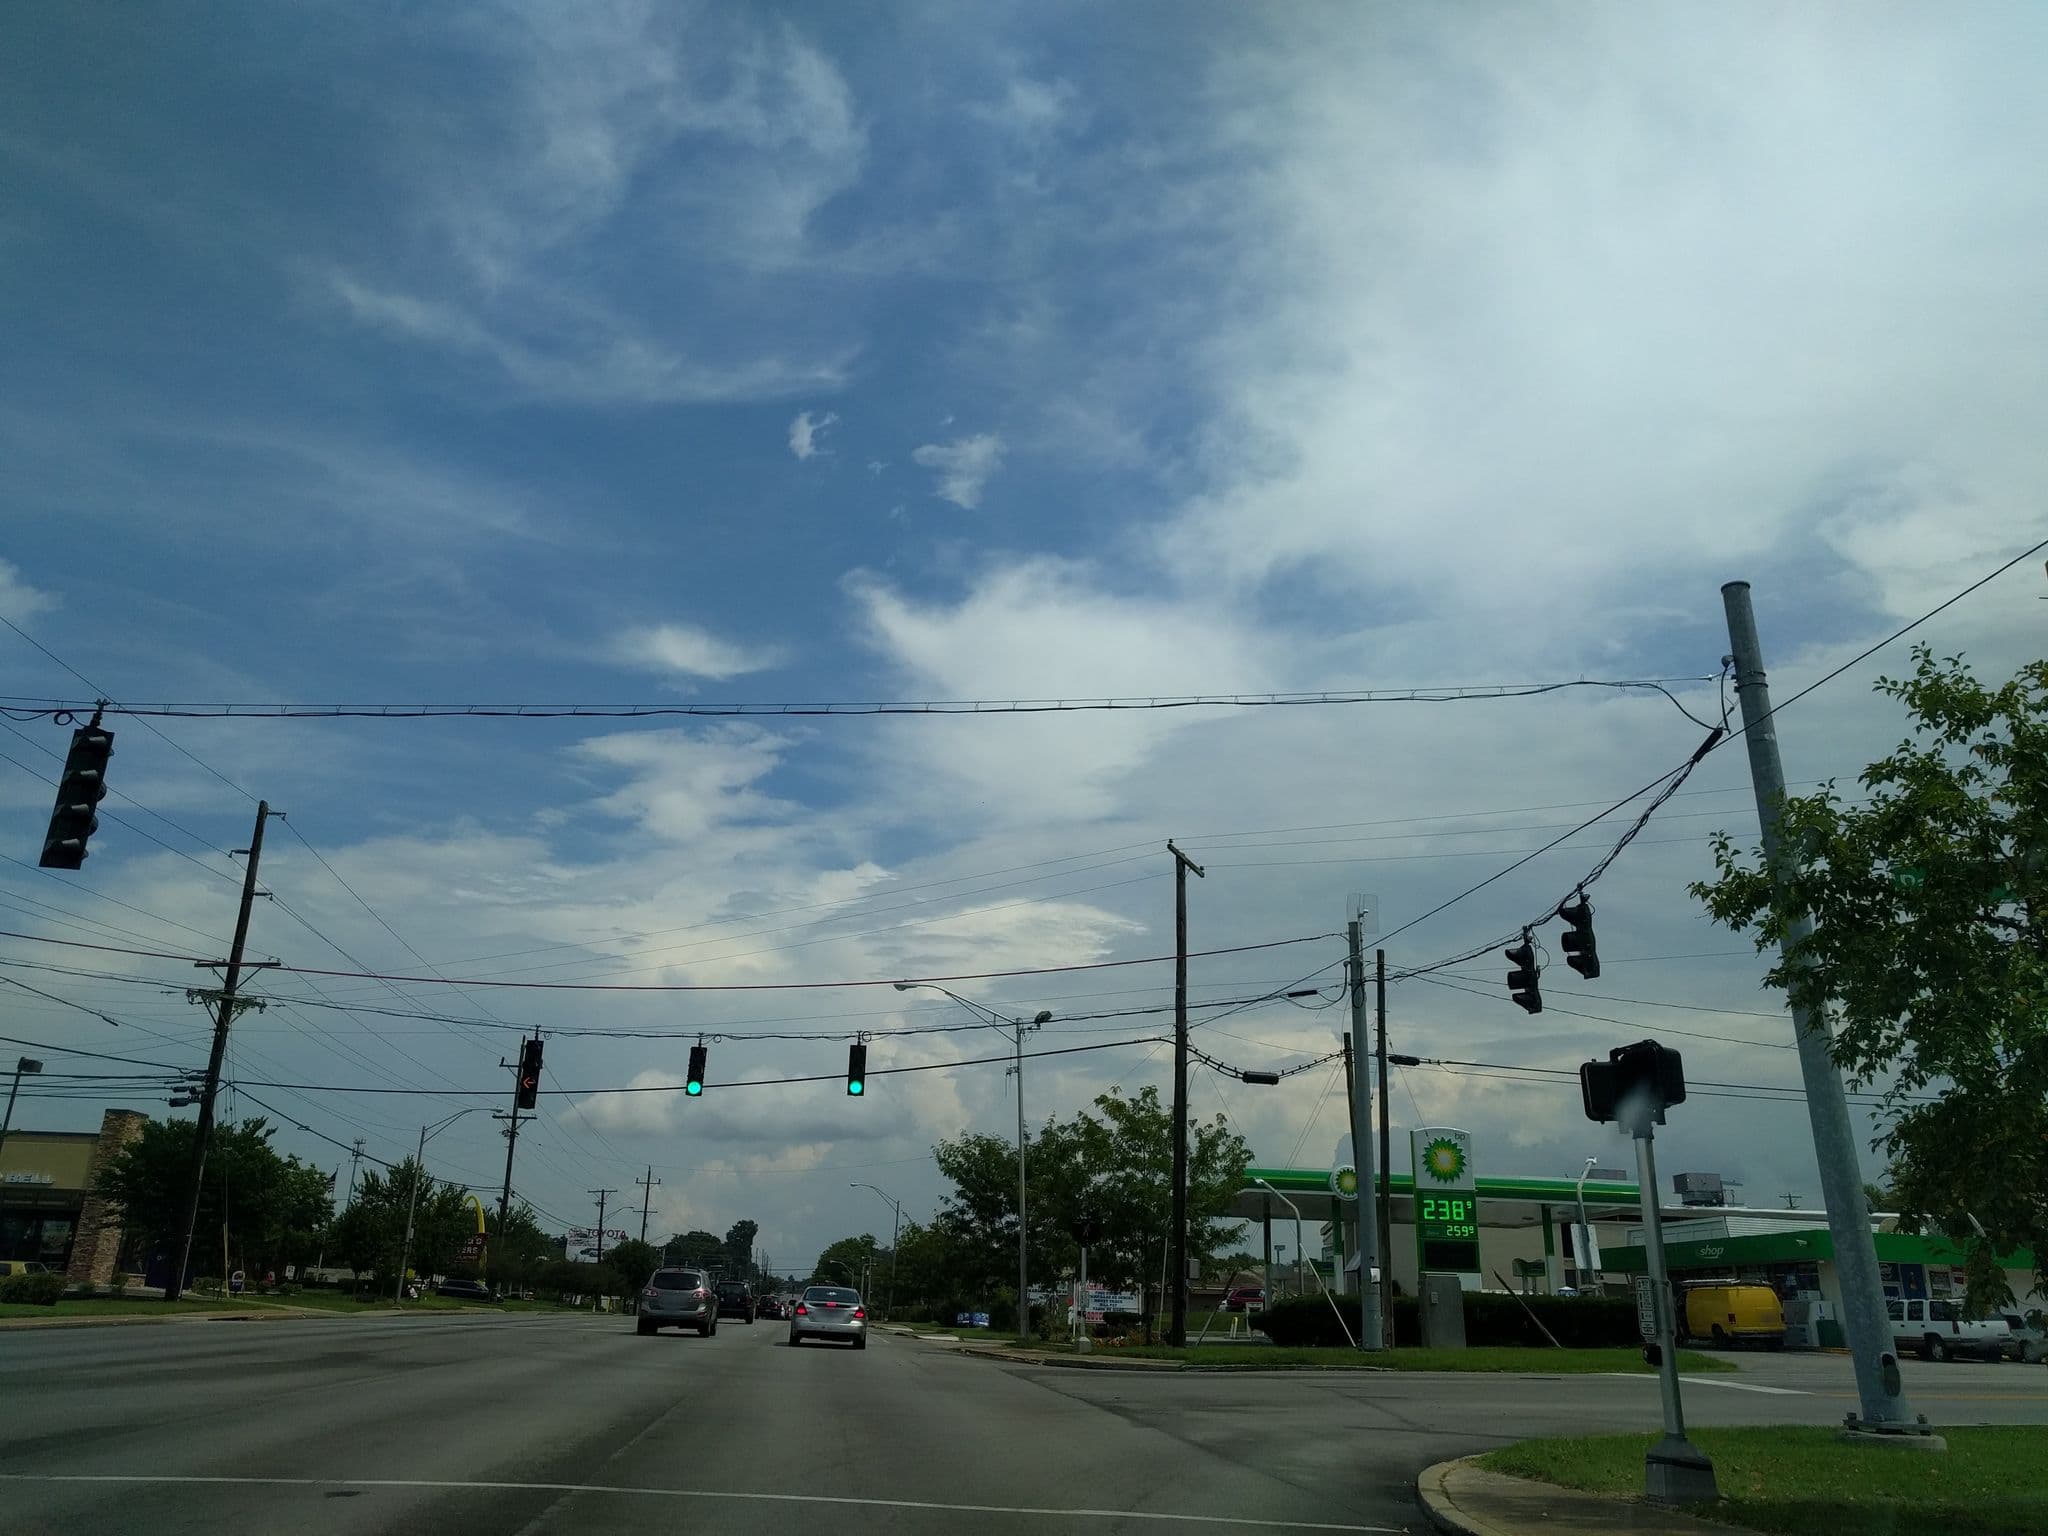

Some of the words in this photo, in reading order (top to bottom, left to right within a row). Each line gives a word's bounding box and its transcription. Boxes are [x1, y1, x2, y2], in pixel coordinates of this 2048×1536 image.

[1454, 1132, 1466, 1141] bp
[5, 1171, 53, 1184] BELL
[586, 1228, 626, 1239] TOYOTA
[1699, 1244, 1725, 1259] shop
